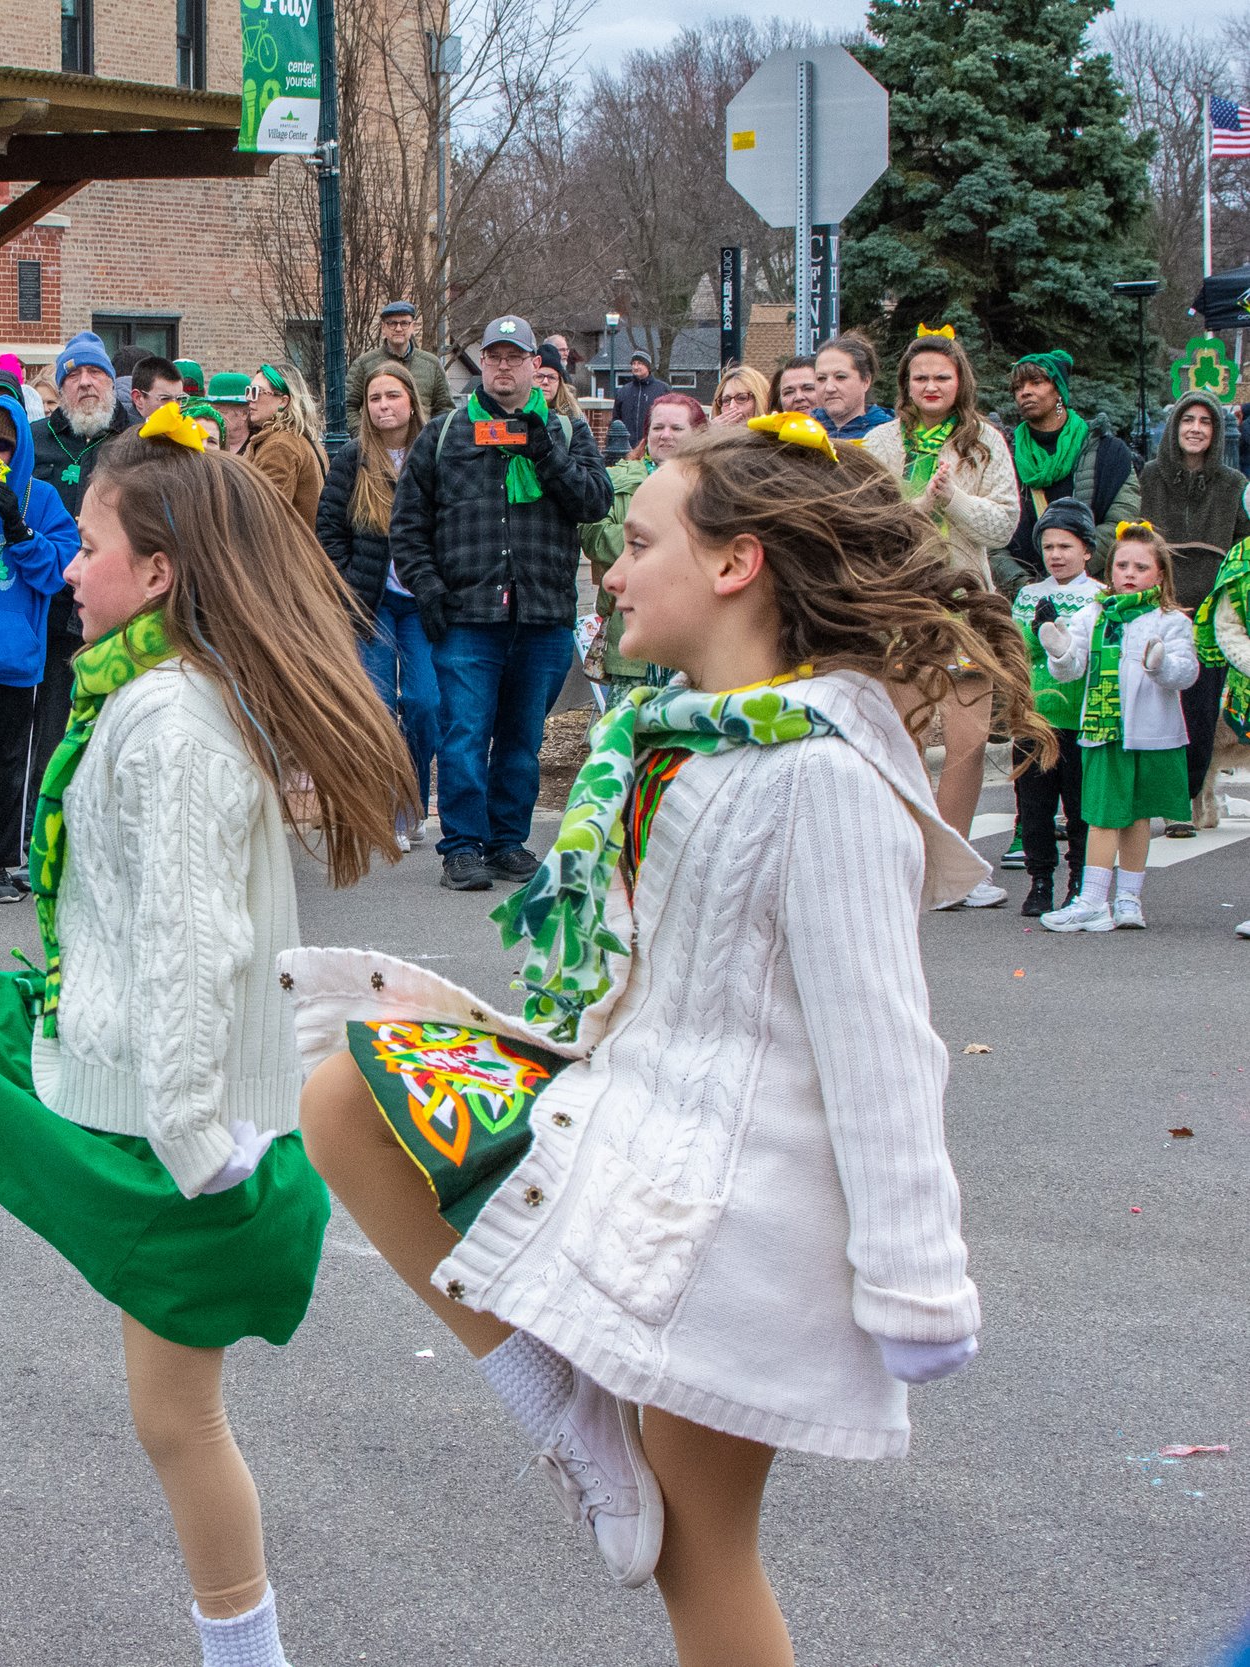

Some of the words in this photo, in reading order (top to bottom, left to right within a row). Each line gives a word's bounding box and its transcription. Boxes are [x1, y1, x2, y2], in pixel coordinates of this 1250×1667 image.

[287, 60, 314, 74] center
[285, 73, 317, 90] yourself
[268, 129, 288, 141] Village
[288, 130, 308, 140] Center
